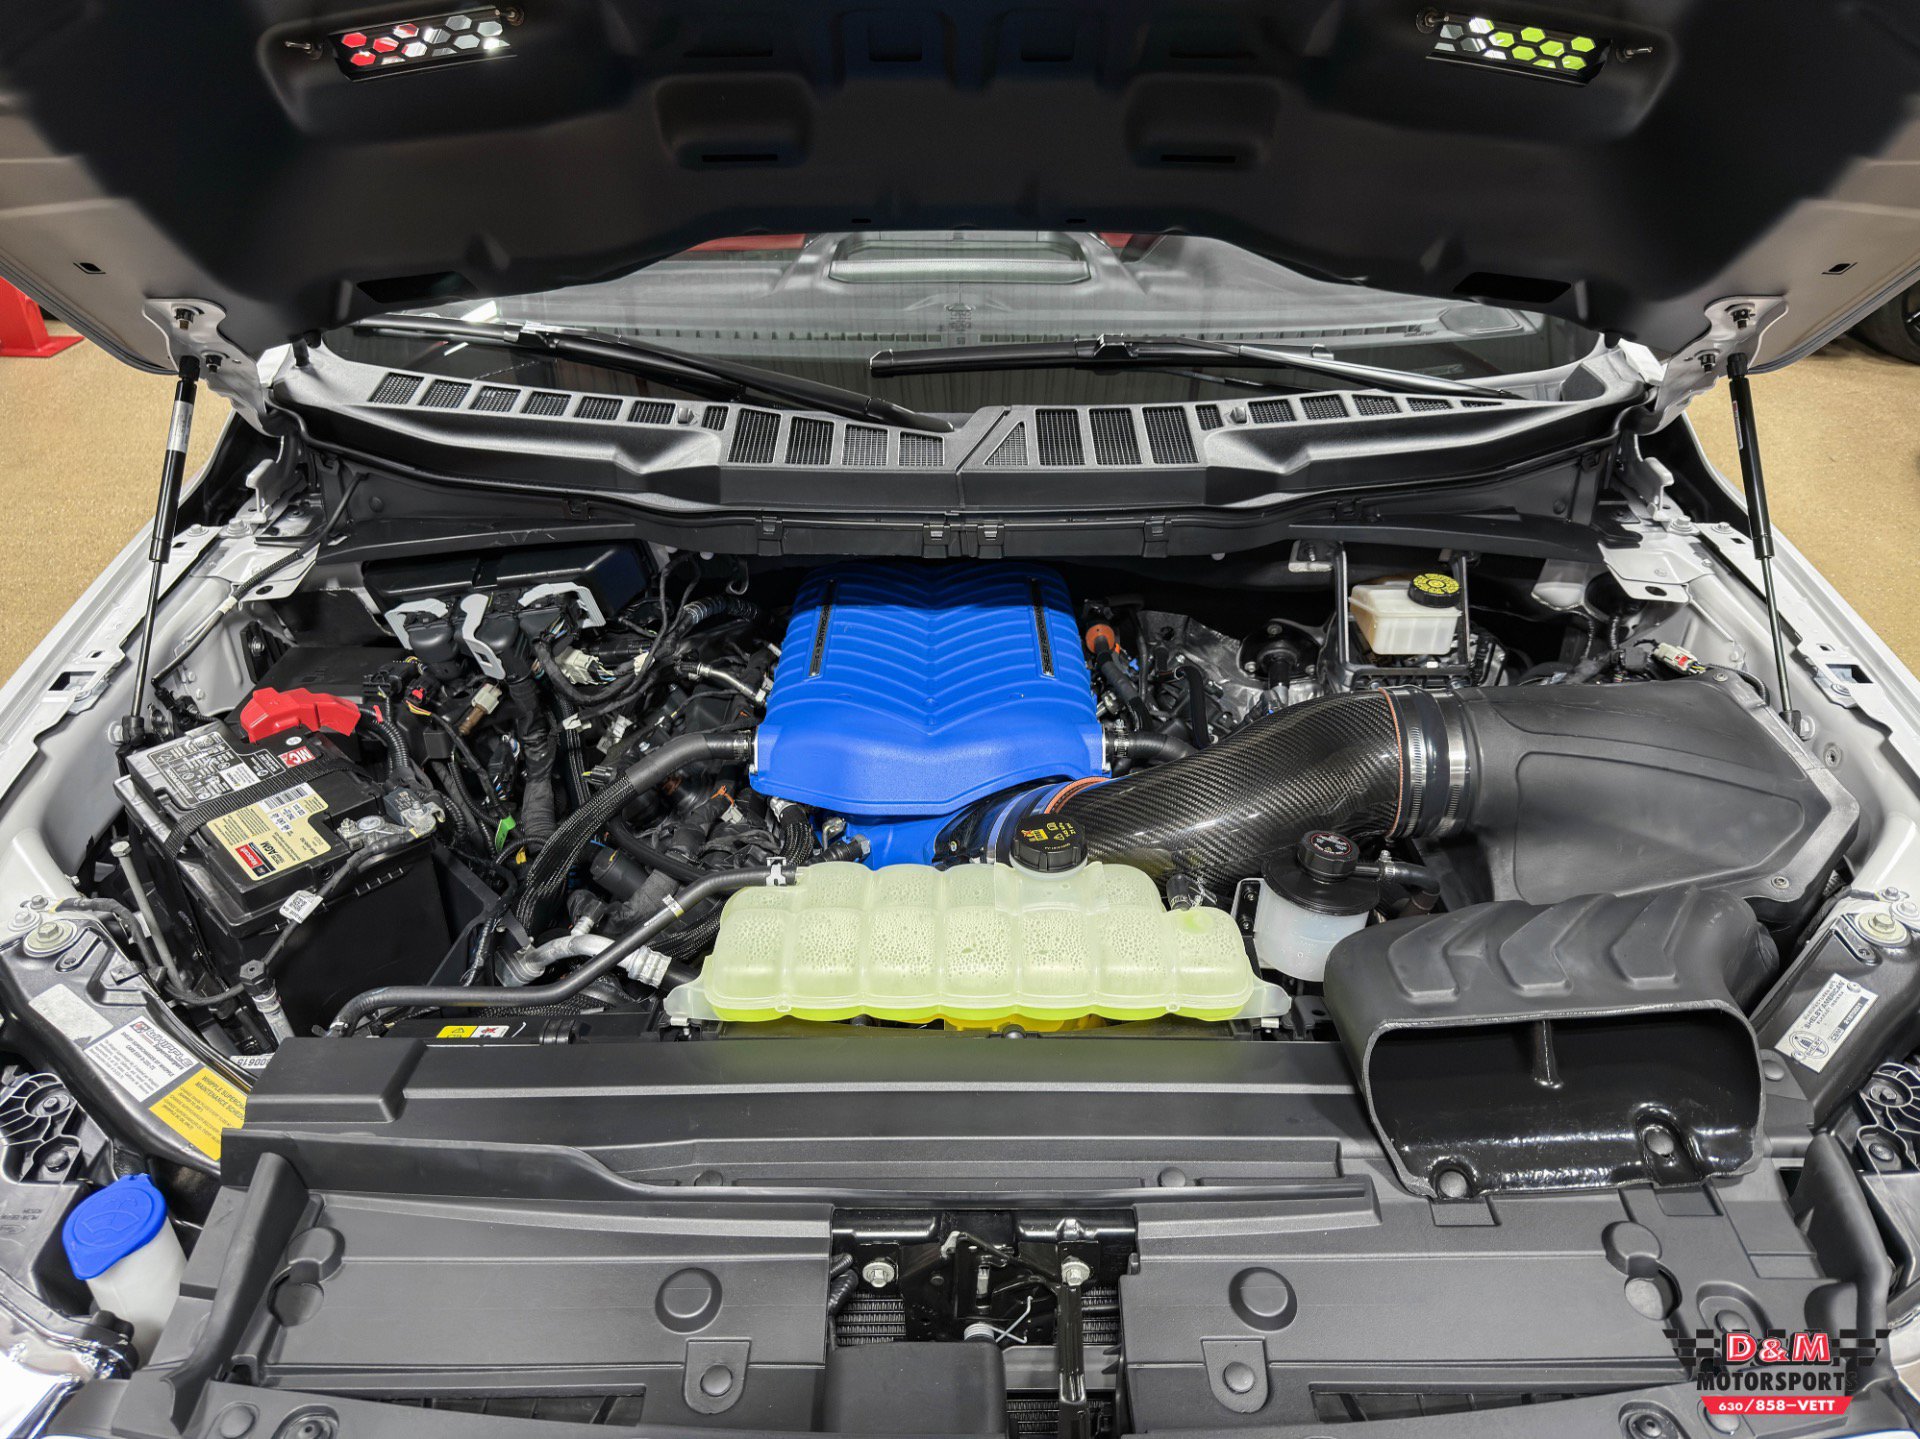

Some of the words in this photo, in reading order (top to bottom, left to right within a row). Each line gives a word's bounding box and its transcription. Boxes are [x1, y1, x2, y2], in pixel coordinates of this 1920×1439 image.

[259, 840, 277, 854] AGM
[1803, 1006, 1823, 1029] SHELBY
[1820, 980, 1844, 1008] AMERICAN
[145, 1027, 193, 1068] WHIPPLE
[152, 1043, 184, 1070] Superchargers
[1805, 1037, 1821, 1056] SHELBY
[194, 1081, 228, 1107] MAINTENANCE
